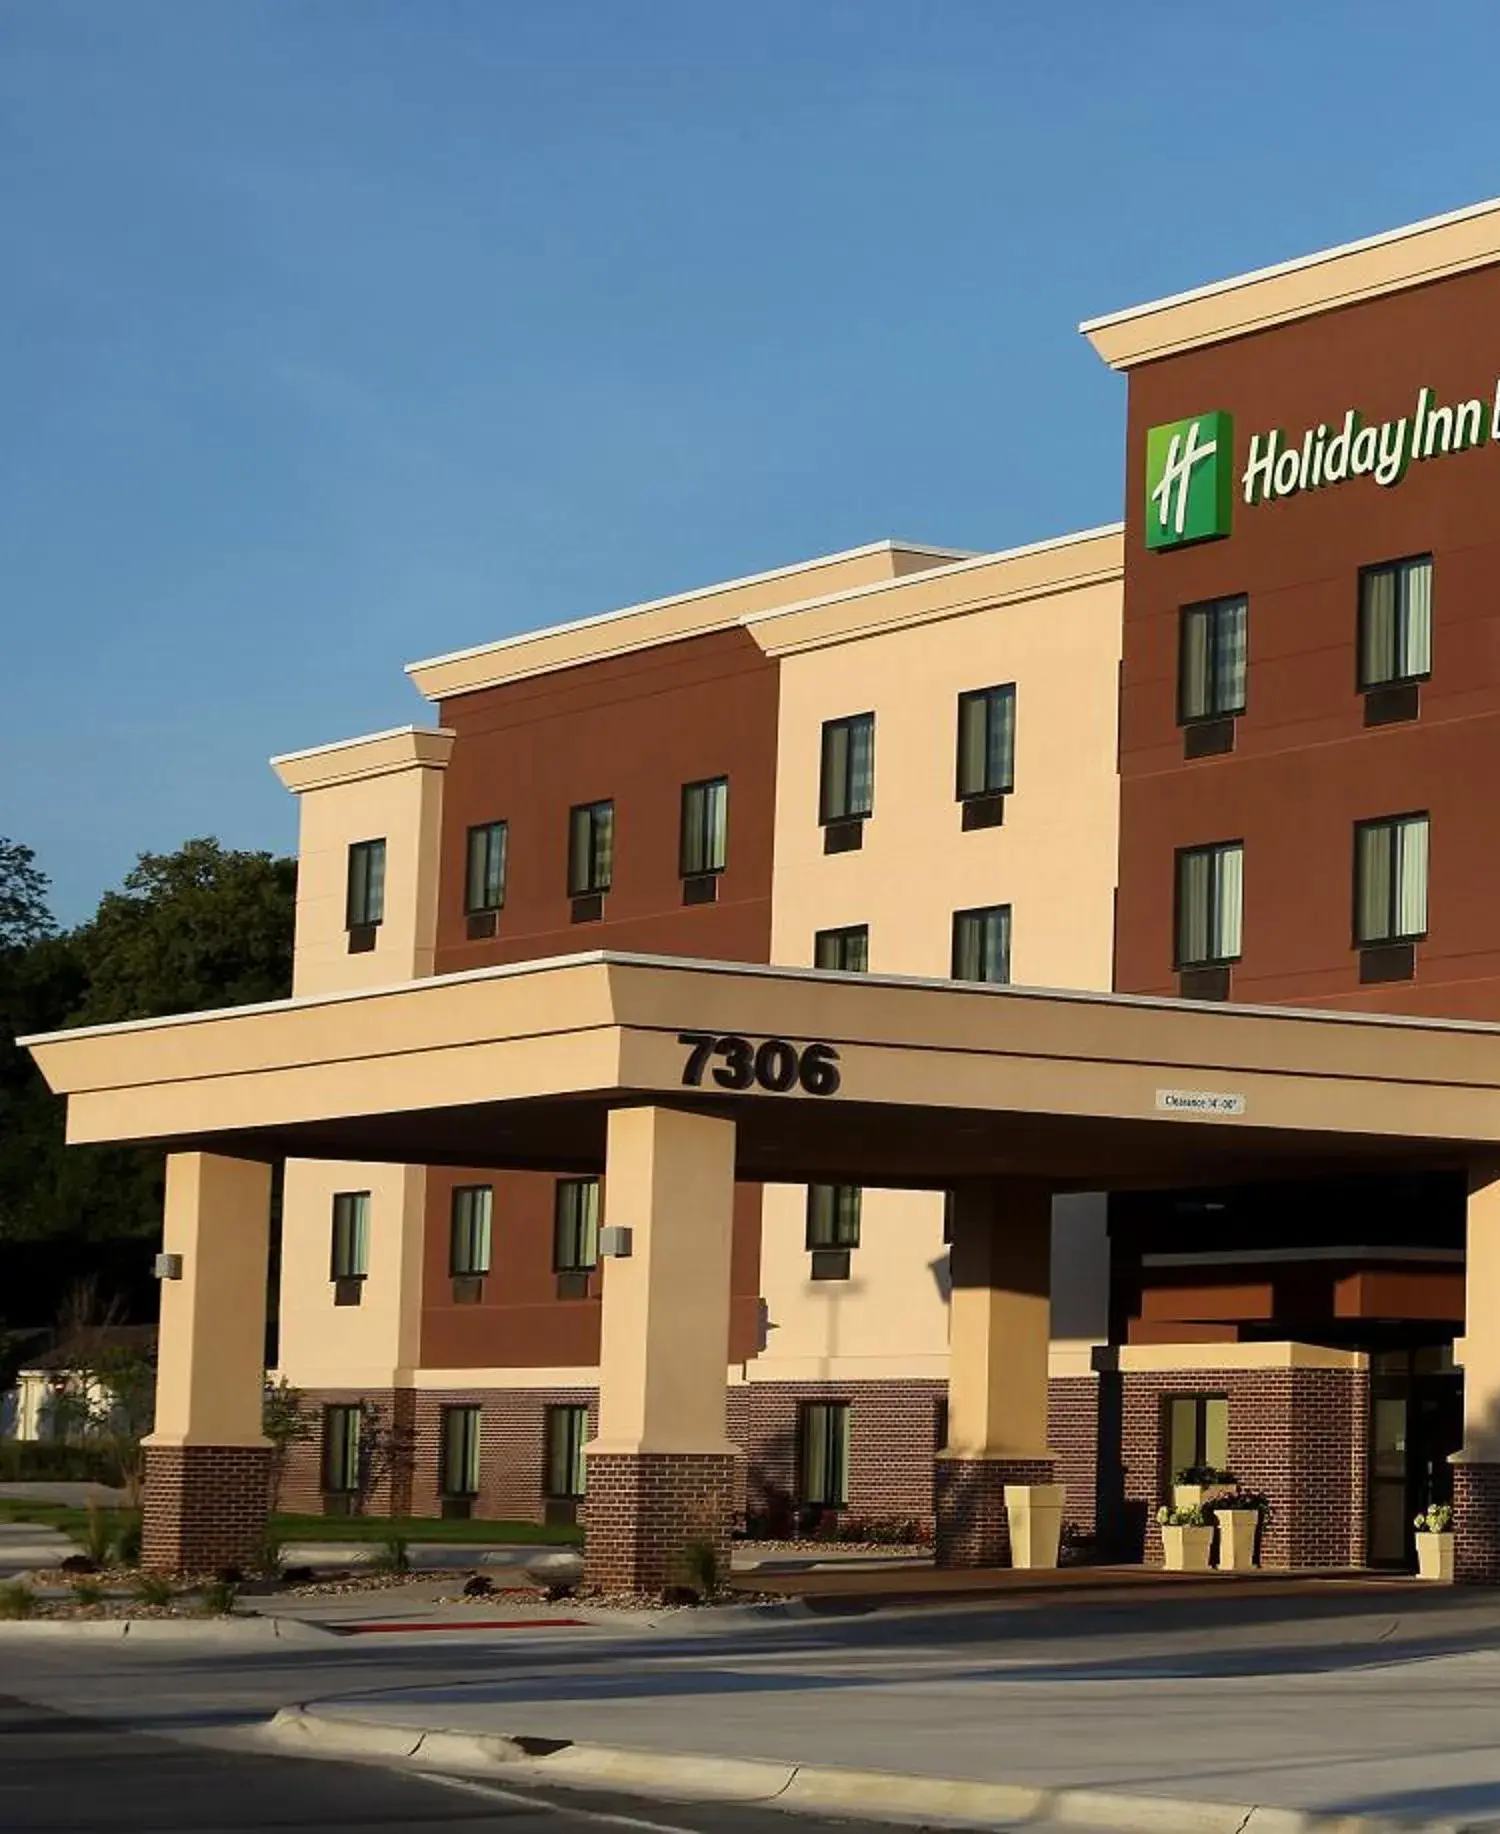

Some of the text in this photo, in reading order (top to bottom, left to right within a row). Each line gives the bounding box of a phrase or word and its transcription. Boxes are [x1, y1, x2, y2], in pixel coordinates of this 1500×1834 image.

[1242, 409, 1406, 504] Holiday
[1411, 387, 1482, 459] Inn
[676, 1034, 841, 1096] 7306
